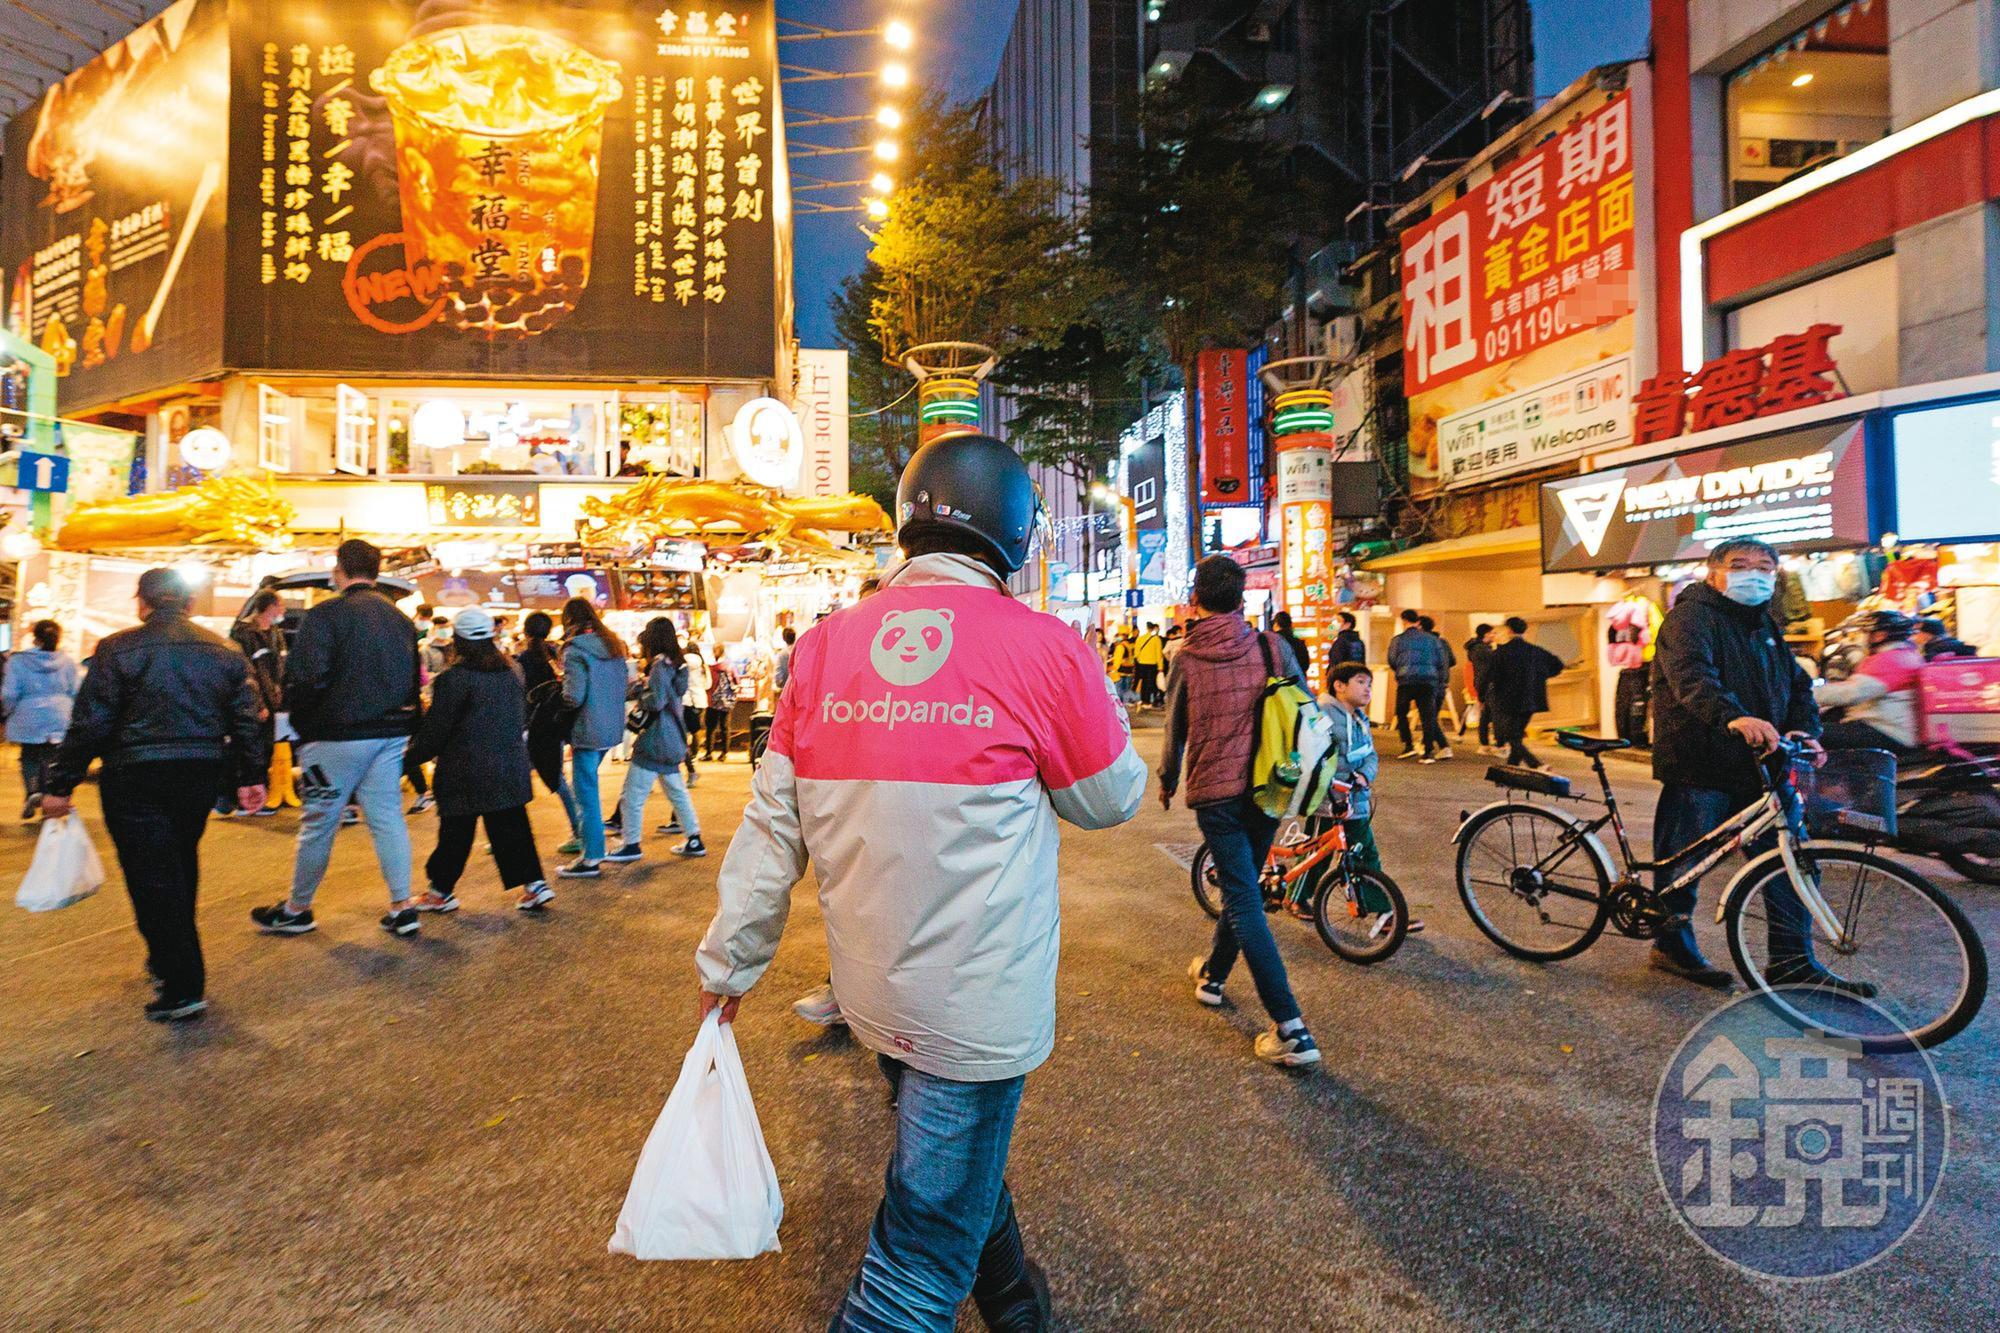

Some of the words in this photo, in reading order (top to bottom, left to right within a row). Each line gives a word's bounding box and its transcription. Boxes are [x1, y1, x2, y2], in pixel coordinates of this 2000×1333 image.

[657, 43, 691, 56] XING
[693, 45, 711, 58] FU
[713, 46, 750, 59] TANG
[651, 76, 667, 102] The
[517, 148, 530, 186] XING
[731, 76, 766, 223] 世界首創
[1487, 98, 1627, 241] 短期
[469, 139, 512, 281] 幸福堂
[1484, 171, 1633, 300] 黃金店面
[517, 241, 530, 281] TANG
[355, 264, 440, 306] NEW
[1404, 210, 1477, 385] 租
[1600, 373, 1623, 404] WC
[1531, 418, 1617, 452] Welcome
[1452, 441, 1518, 476] 歡迎使用
[1623, 475, 1702, 514] NEW
[1702, 450, 1834, 500] DIVIDE
[1795, 485, 1832, 498] YOU
[821, 691, 995, 731] foodpanda
